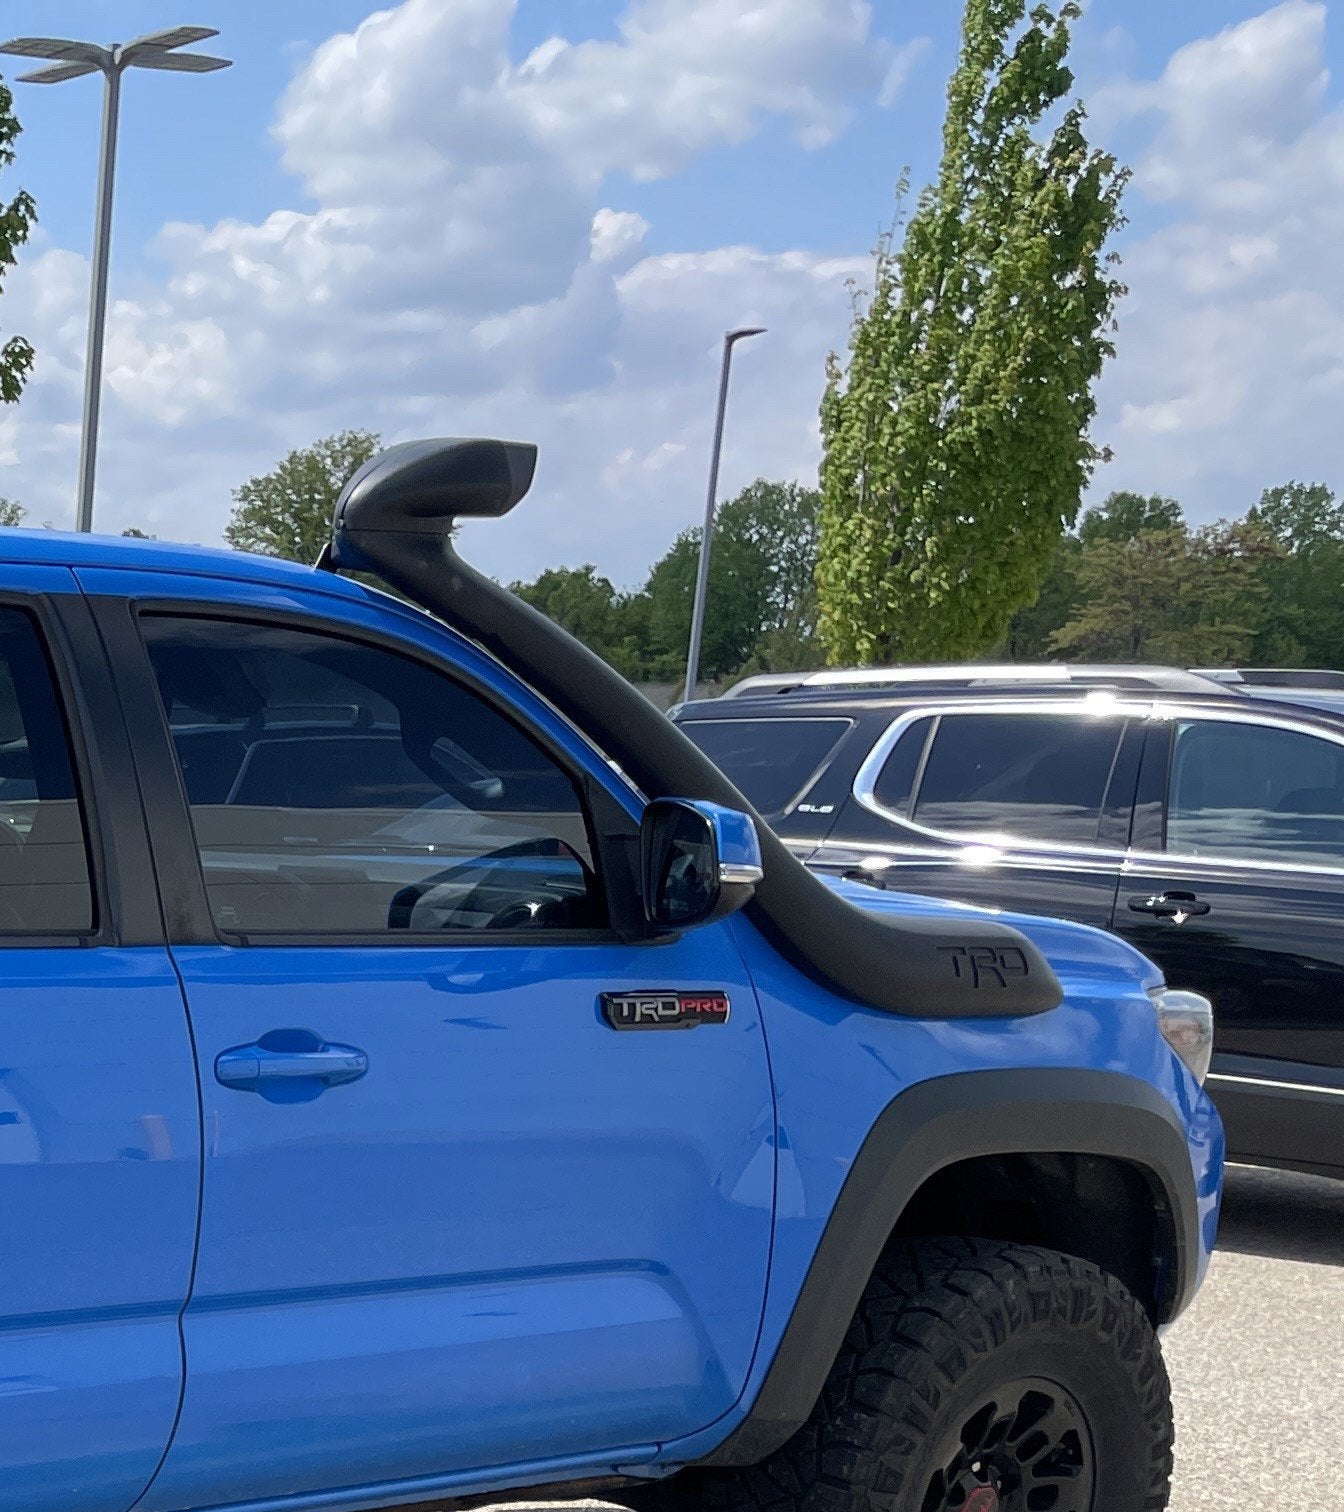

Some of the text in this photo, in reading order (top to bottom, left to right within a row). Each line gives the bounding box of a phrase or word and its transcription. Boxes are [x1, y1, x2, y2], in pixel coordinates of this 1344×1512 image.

[936, 946, 1029, 989] TRD
[613, 998, 728, 1022] TRD PRO
